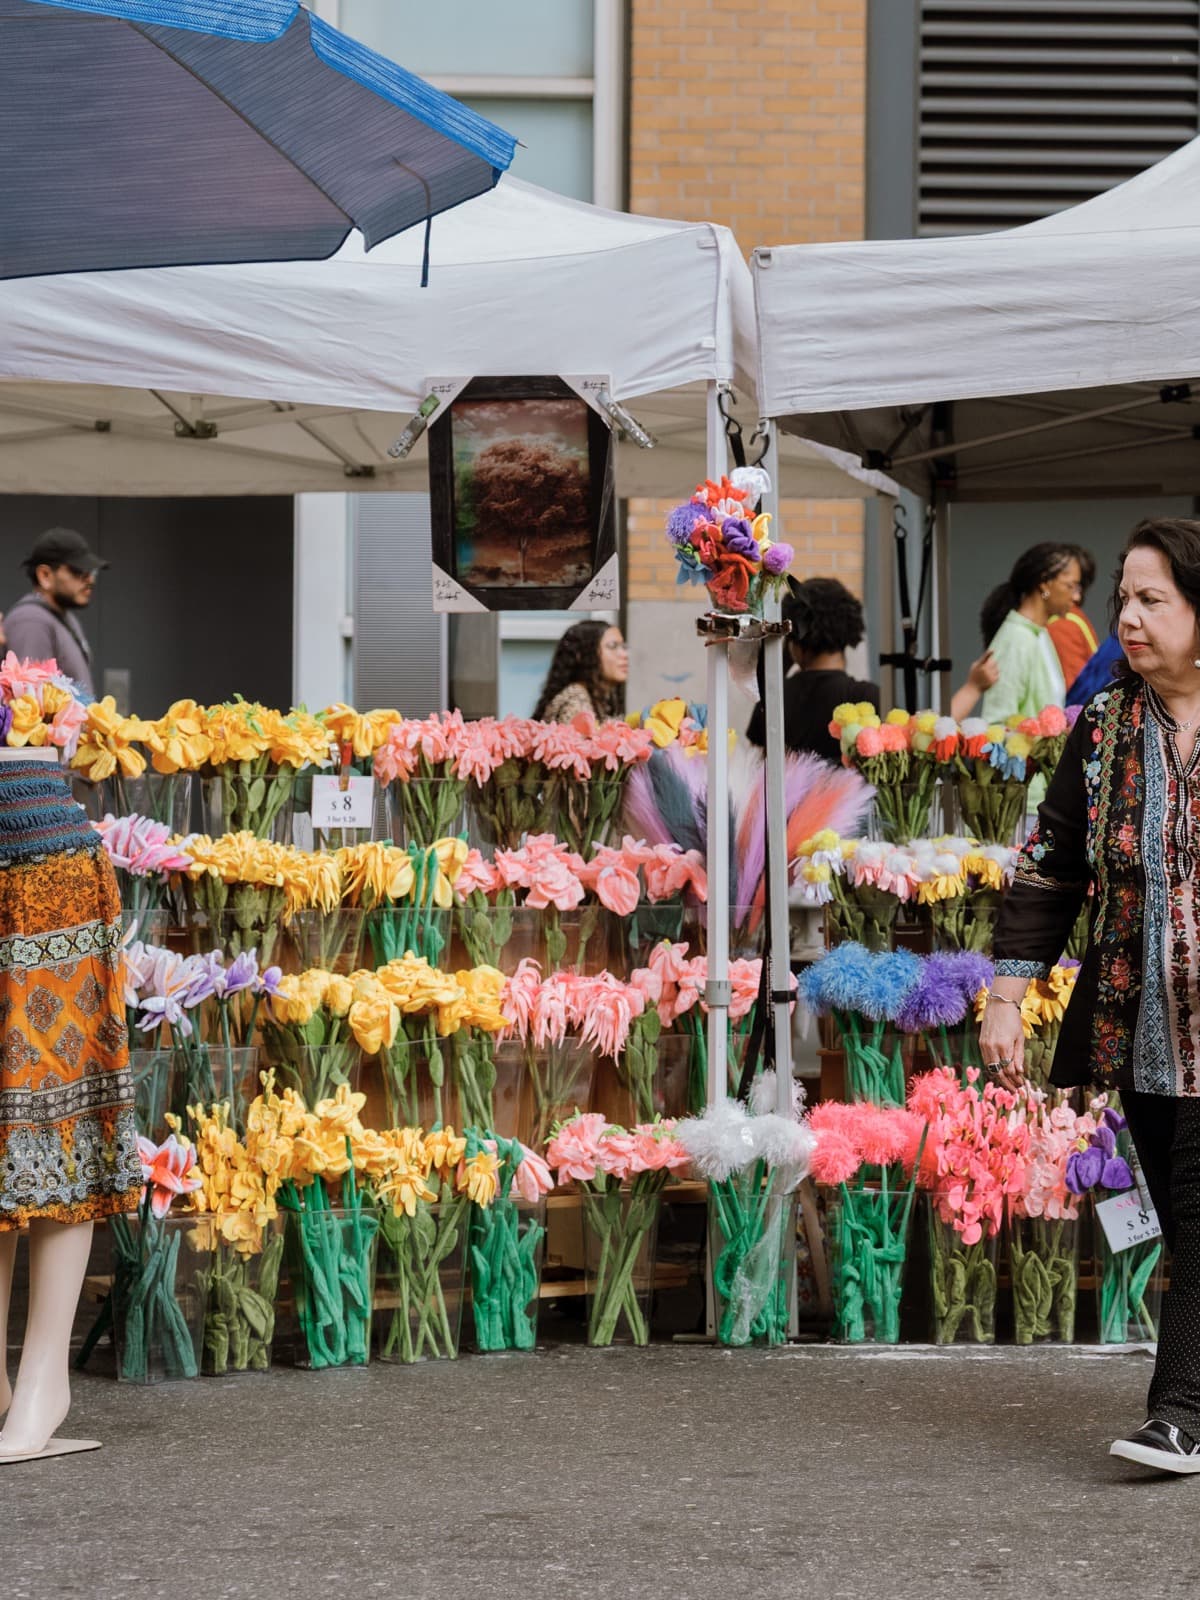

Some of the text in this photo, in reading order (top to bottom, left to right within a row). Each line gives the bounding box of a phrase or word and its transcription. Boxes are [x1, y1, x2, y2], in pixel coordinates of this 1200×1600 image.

[343, 795, 352, 810] 8
[1115, 1195, 1138, 1210] SAL
[1138, 1210, 1150, 1225] 8
